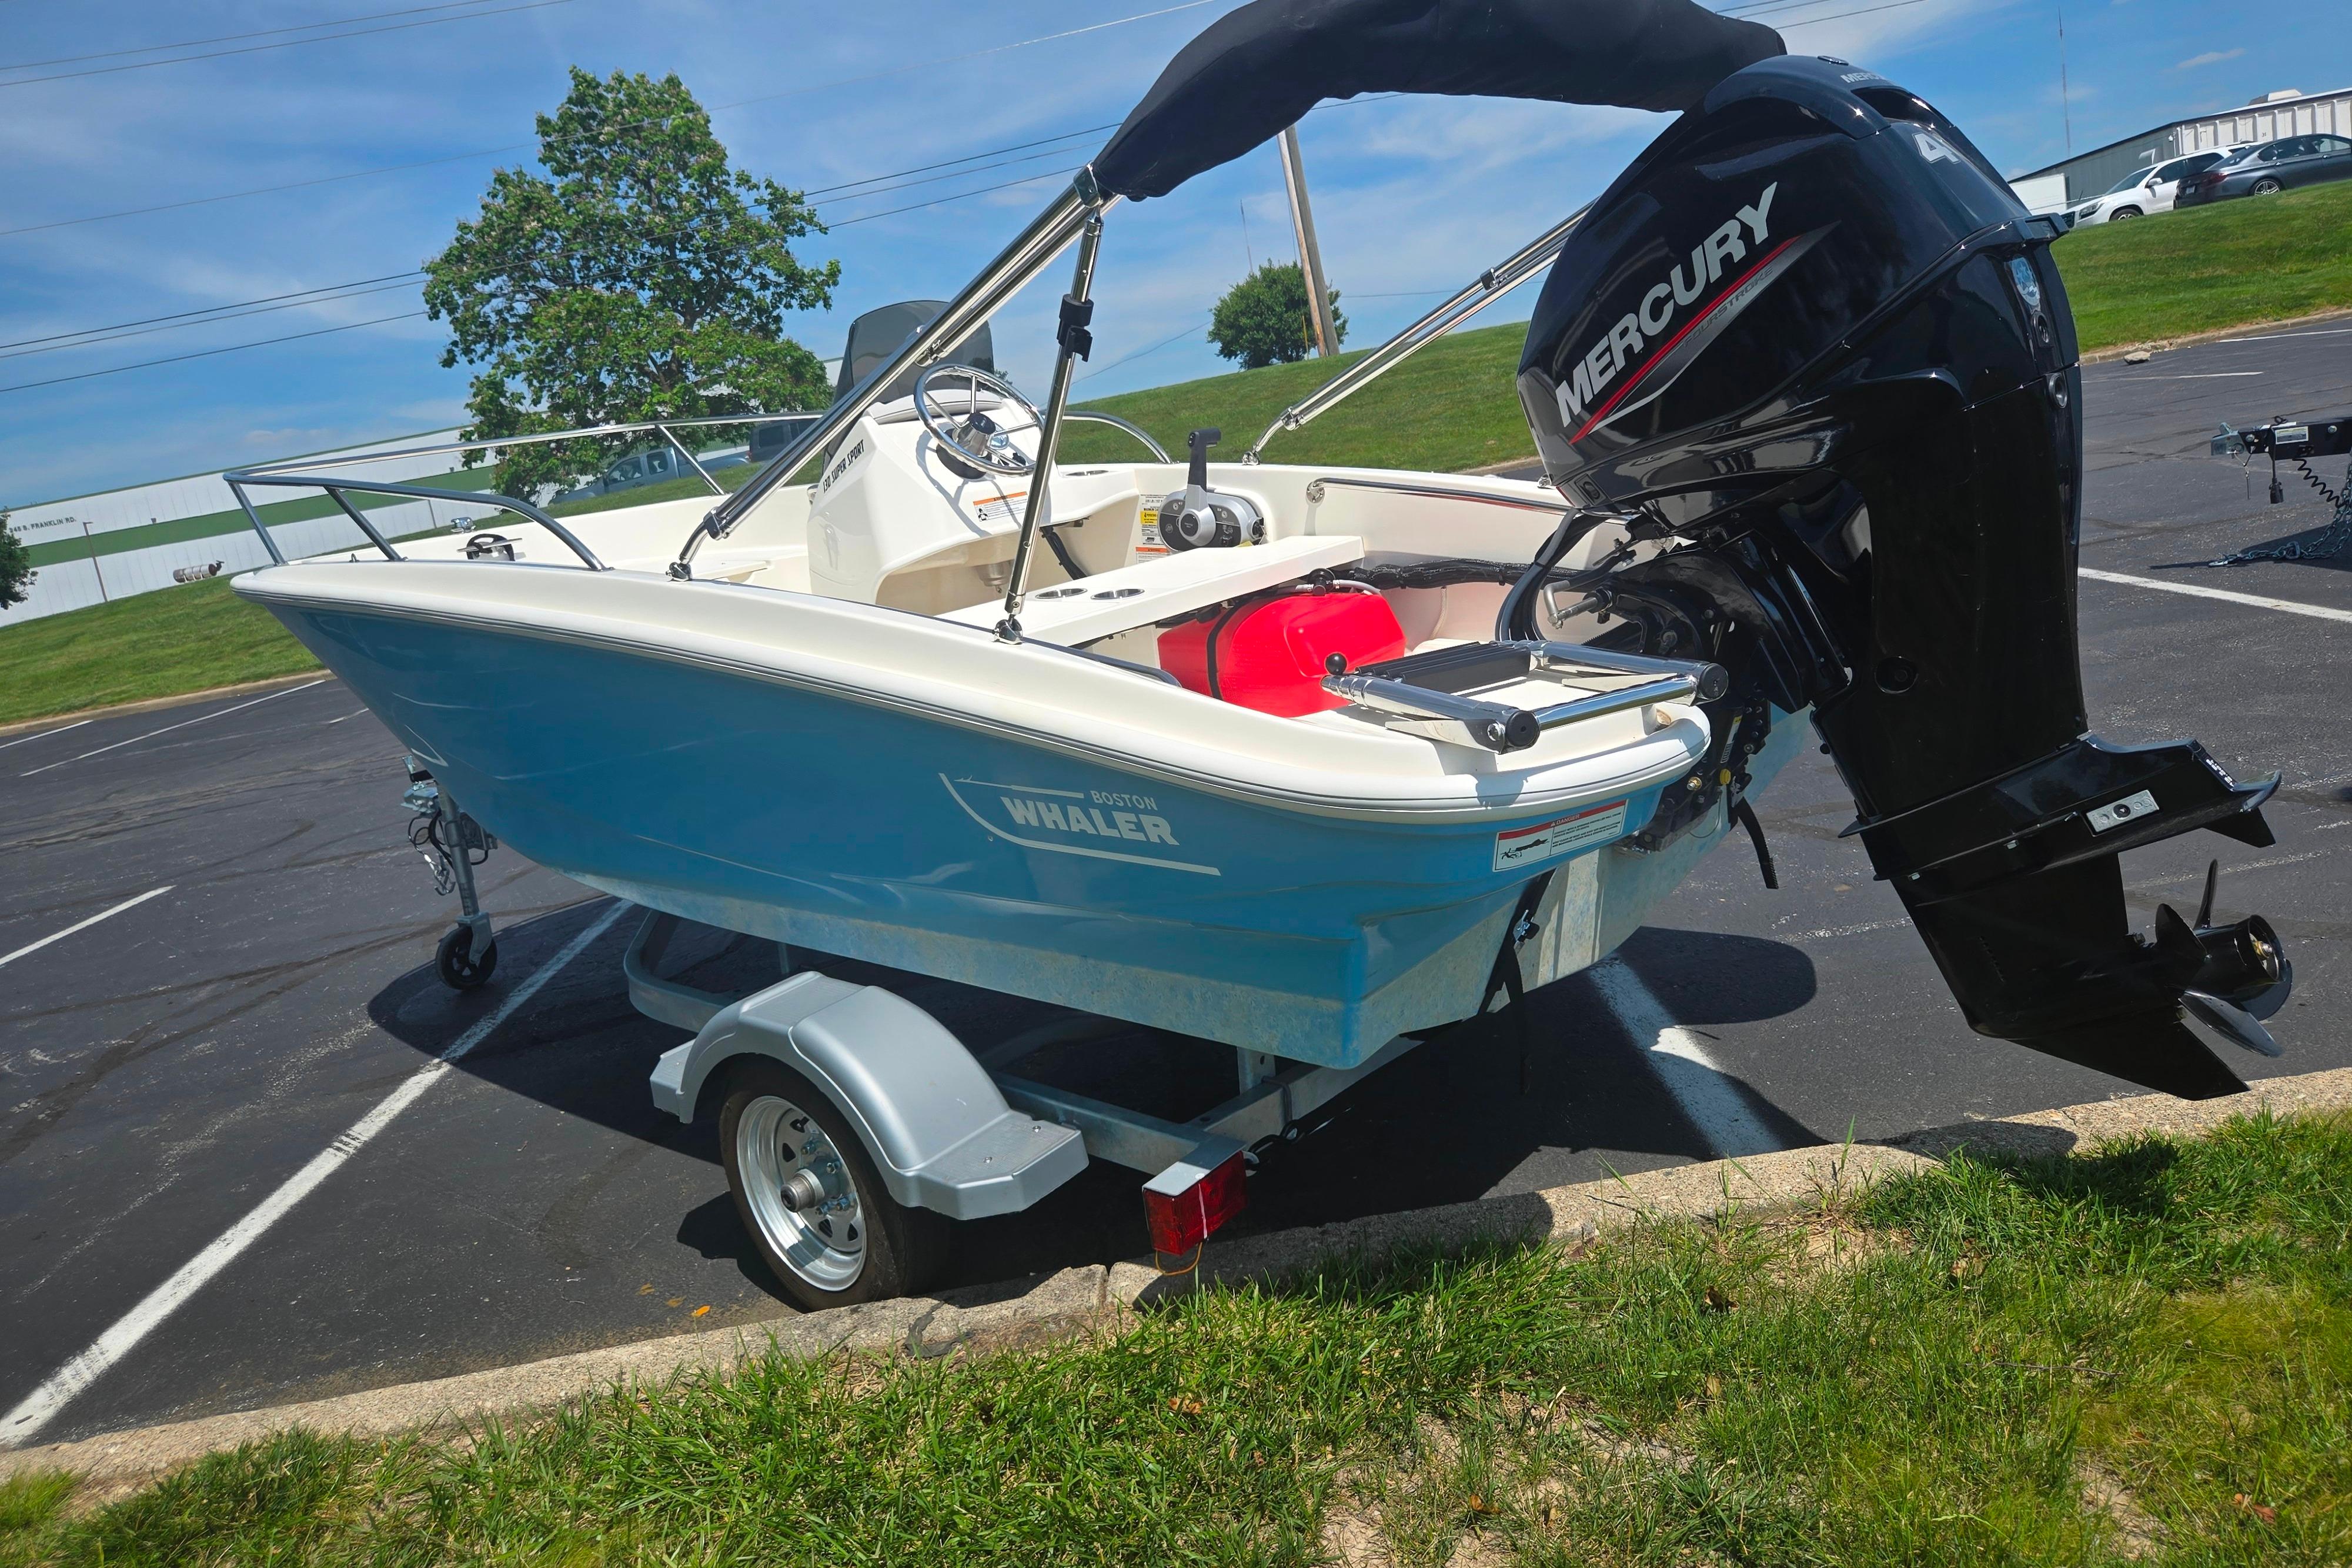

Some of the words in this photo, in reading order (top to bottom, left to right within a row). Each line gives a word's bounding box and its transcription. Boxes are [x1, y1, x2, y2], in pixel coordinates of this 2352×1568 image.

[1555, 181, 1778, 427] MERCURY
[1683, 266, 1773, 348] FOURSTROKE
[823, 475, 831, 494] 130
[831, 457, 847, 484] SUPER
[847, 439, 864, 466] SPORT
[31, 519, 64, 530] FRANKLIN
[1000, 796, 1181, 845] WHALER
[1090, 790, 1158, 811] BOSTON
[1556, 814, 1581, 825] DANGER
